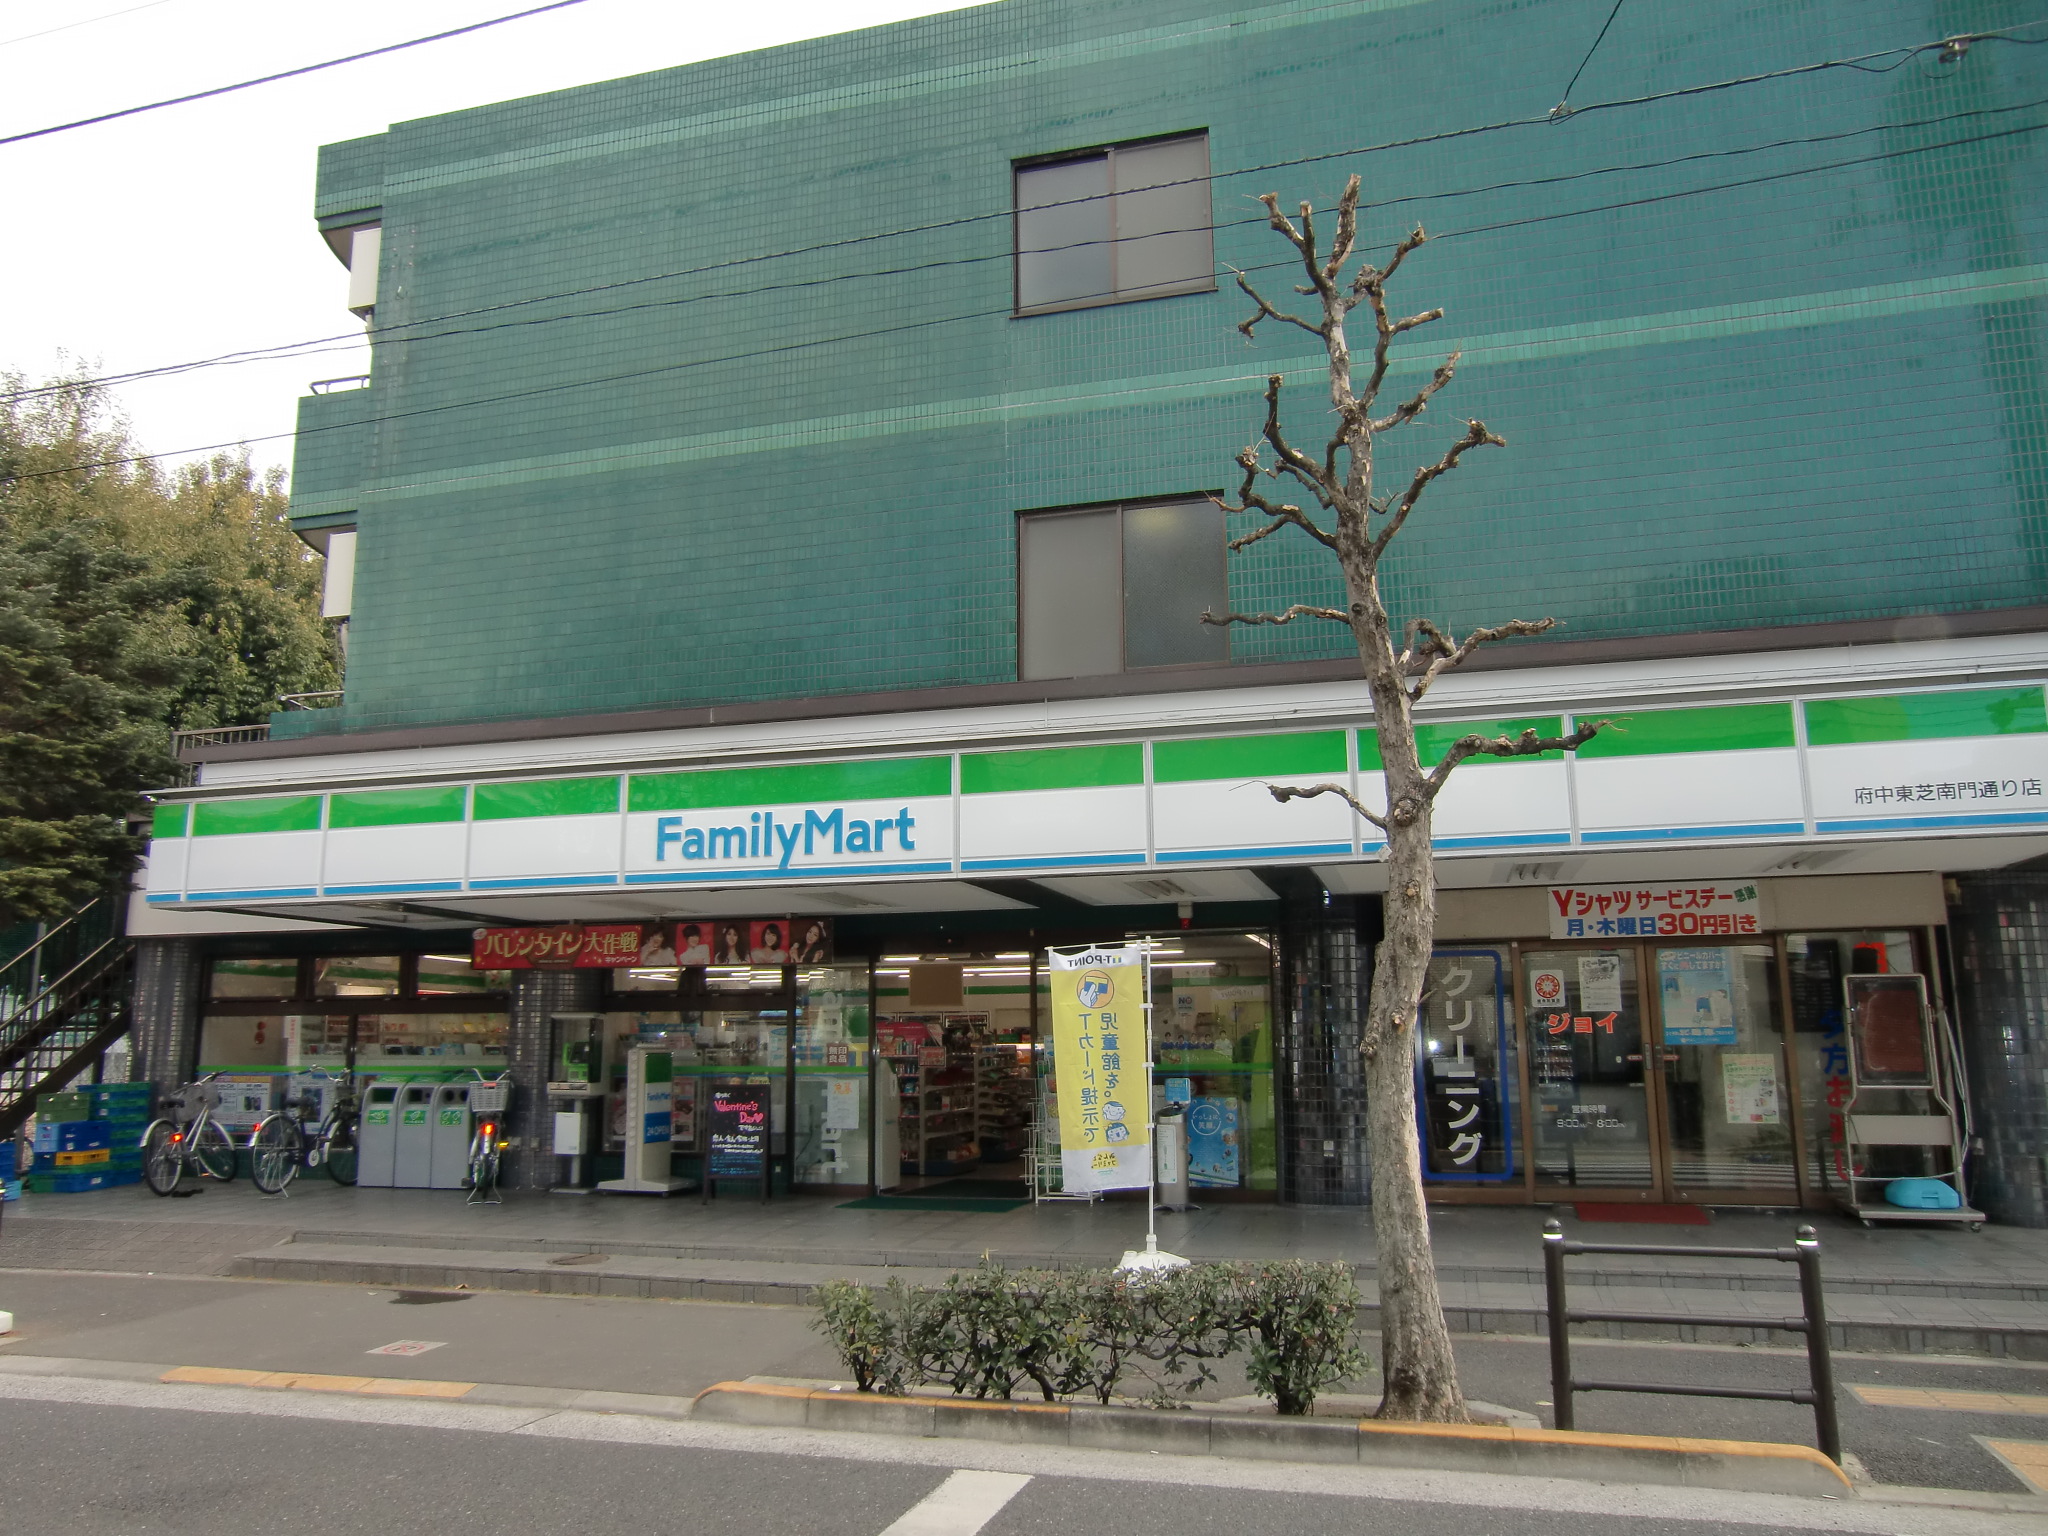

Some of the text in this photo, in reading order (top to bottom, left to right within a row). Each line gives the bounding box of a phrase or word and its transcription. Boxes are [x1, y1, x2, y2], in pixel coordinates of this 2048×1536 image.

[1855, 778, 2042, 804] 府中東芝南門通り店
[656, 806, 916, 869] FamilyMart
[1547, 1012, 1618, 1035] ジョイ
[1441, 966, 1482, 1165] クリーニング
[714, 1100, 759, 1112] Valentine's
